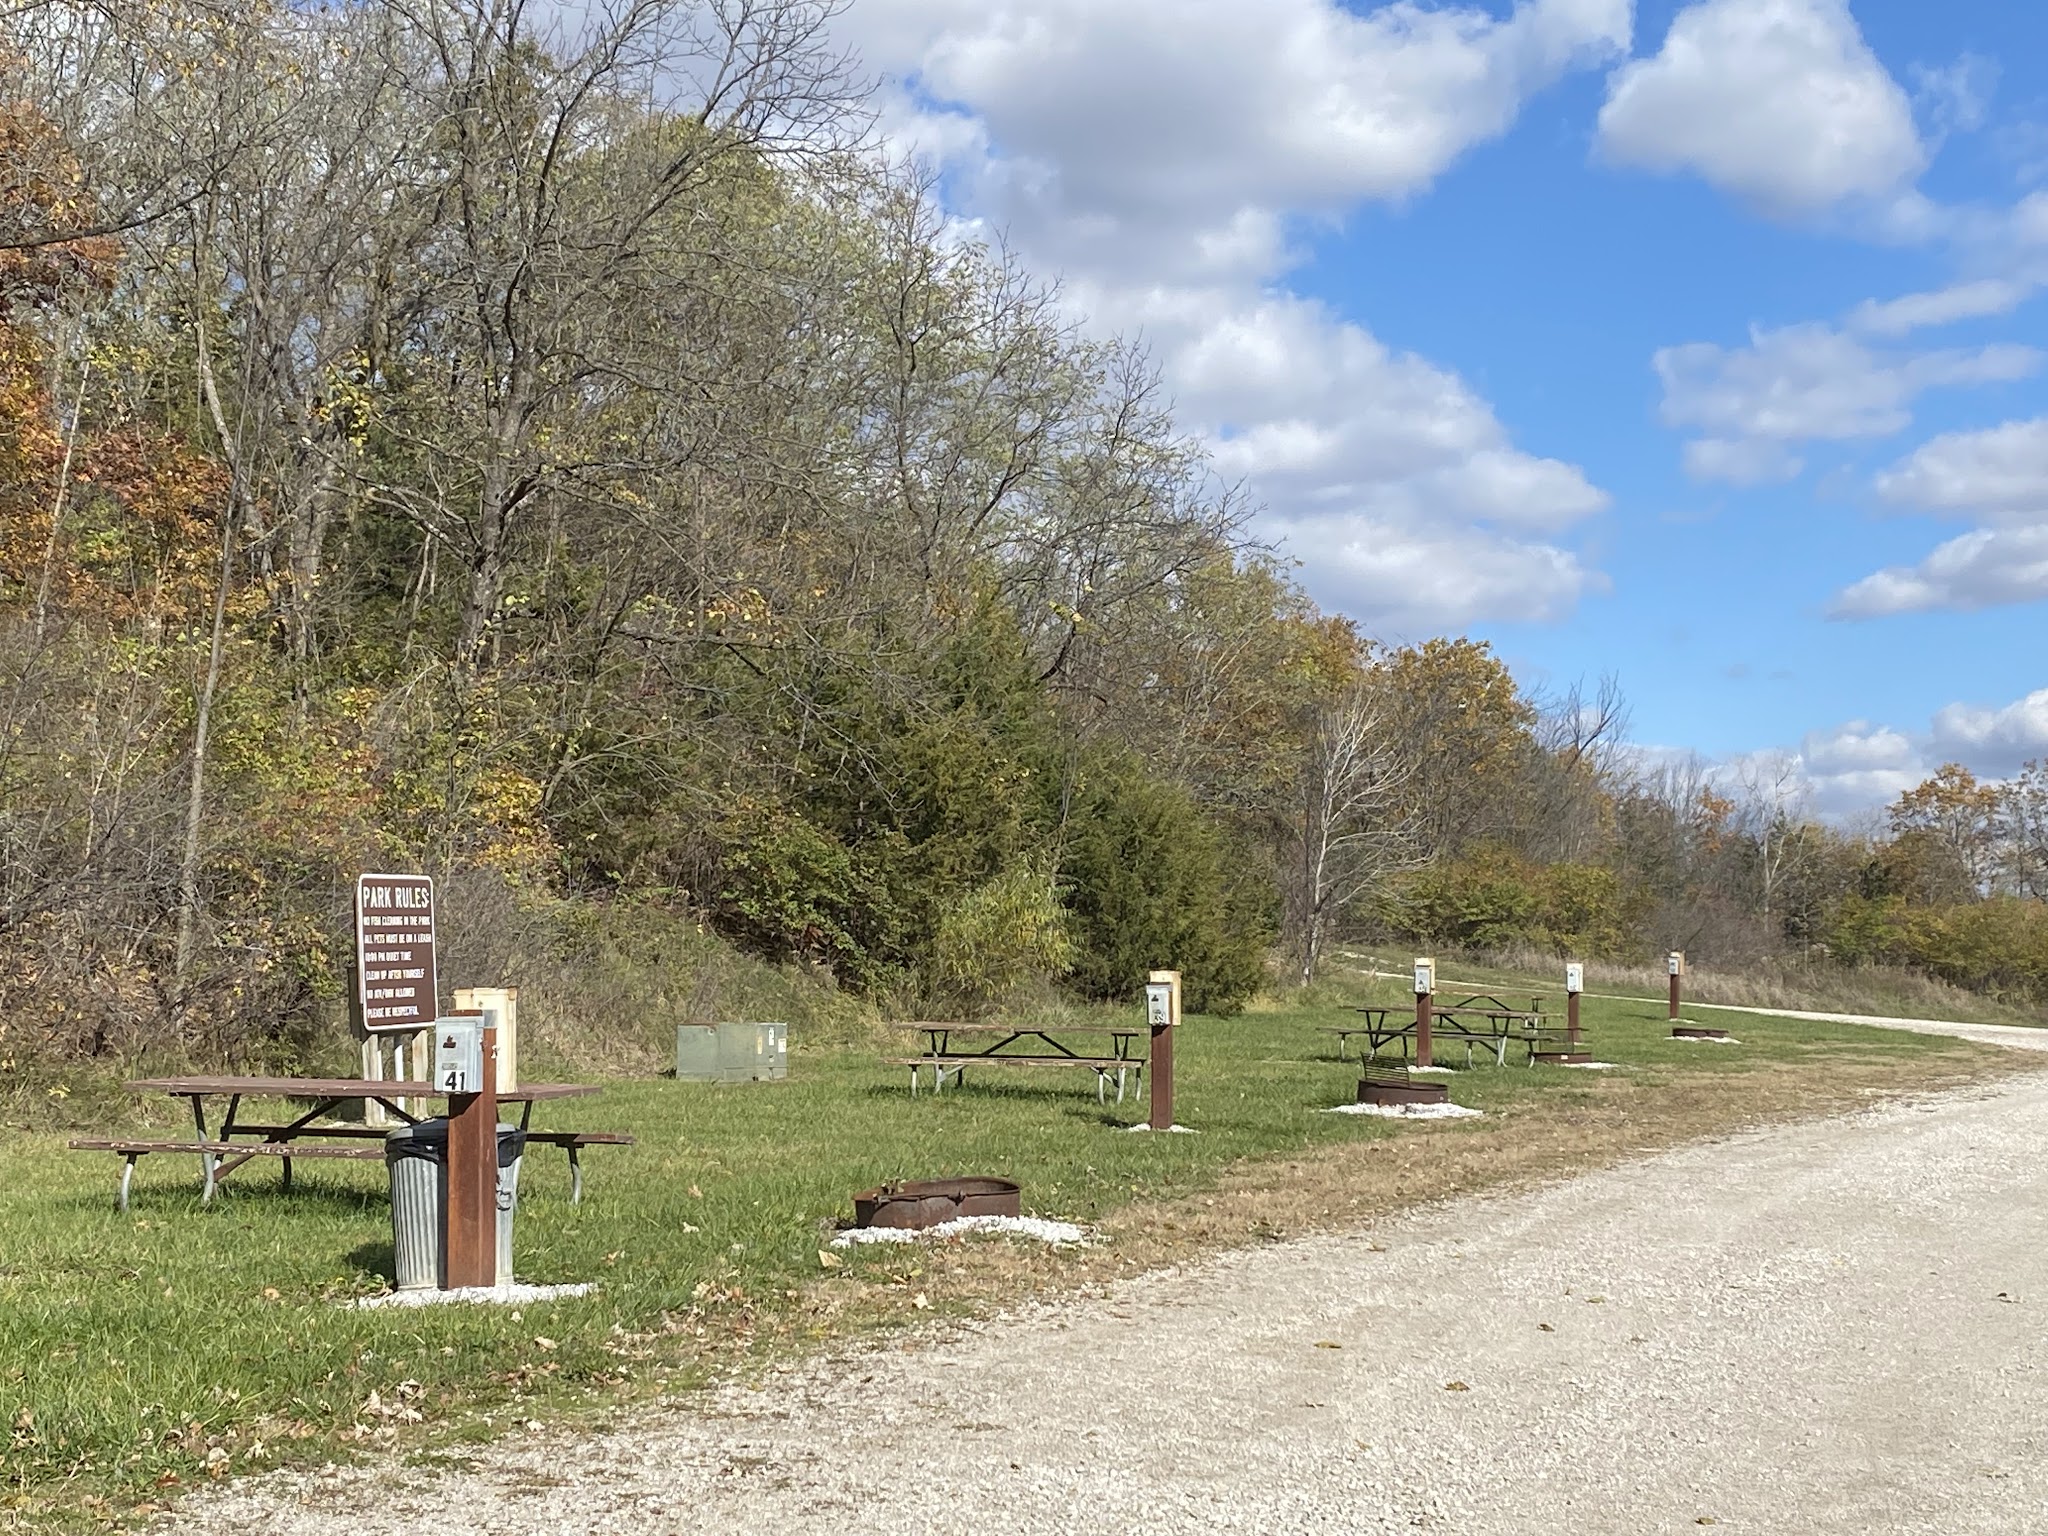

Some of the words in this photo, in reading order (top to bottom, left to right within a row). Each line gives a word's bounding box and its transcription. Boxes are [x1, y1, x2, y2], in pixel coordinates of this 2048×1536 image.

[363, 886, 392, 908] PARK
[395, 887, 430, 908] RULES
[418, 915, 431, 926] PARK
[373, 934, 385, 944] PETS
[399, 933, 405, 943] BE
[367, 1007, 384, 1018] PLEASE
[444, 1071, 466, 1091] 41
